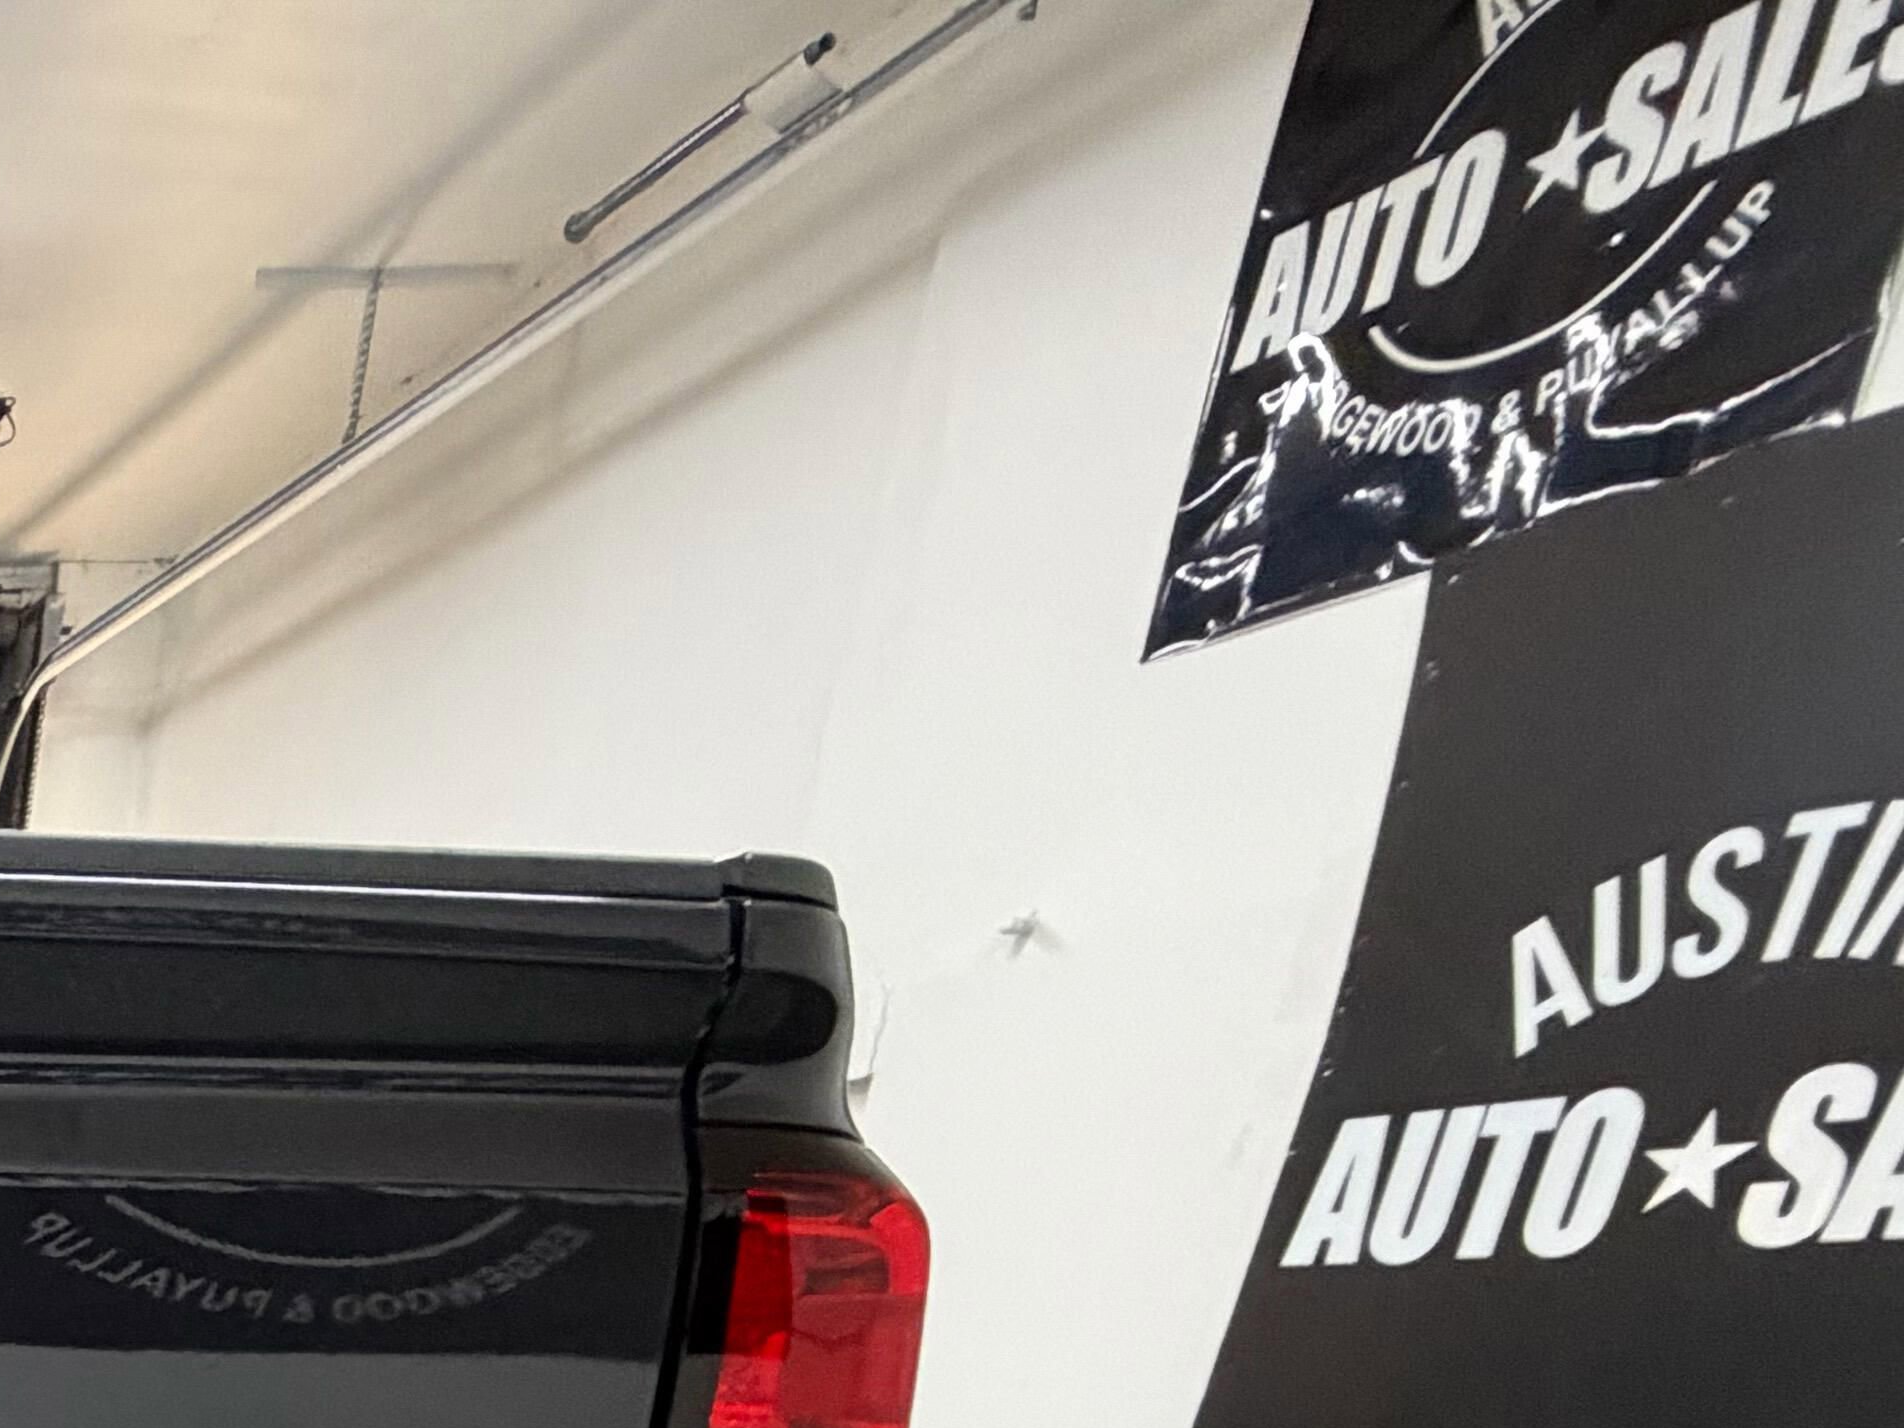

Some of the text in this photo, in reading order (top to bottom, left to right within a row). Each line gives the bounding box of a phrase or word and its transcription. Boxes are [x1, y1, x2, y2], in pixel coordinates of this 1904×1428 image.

[1230, 129, 1506, 374] AUTO
[1491, 389, 1522, 434] &
[1279, 1086, 1645, 1267] AUTO
